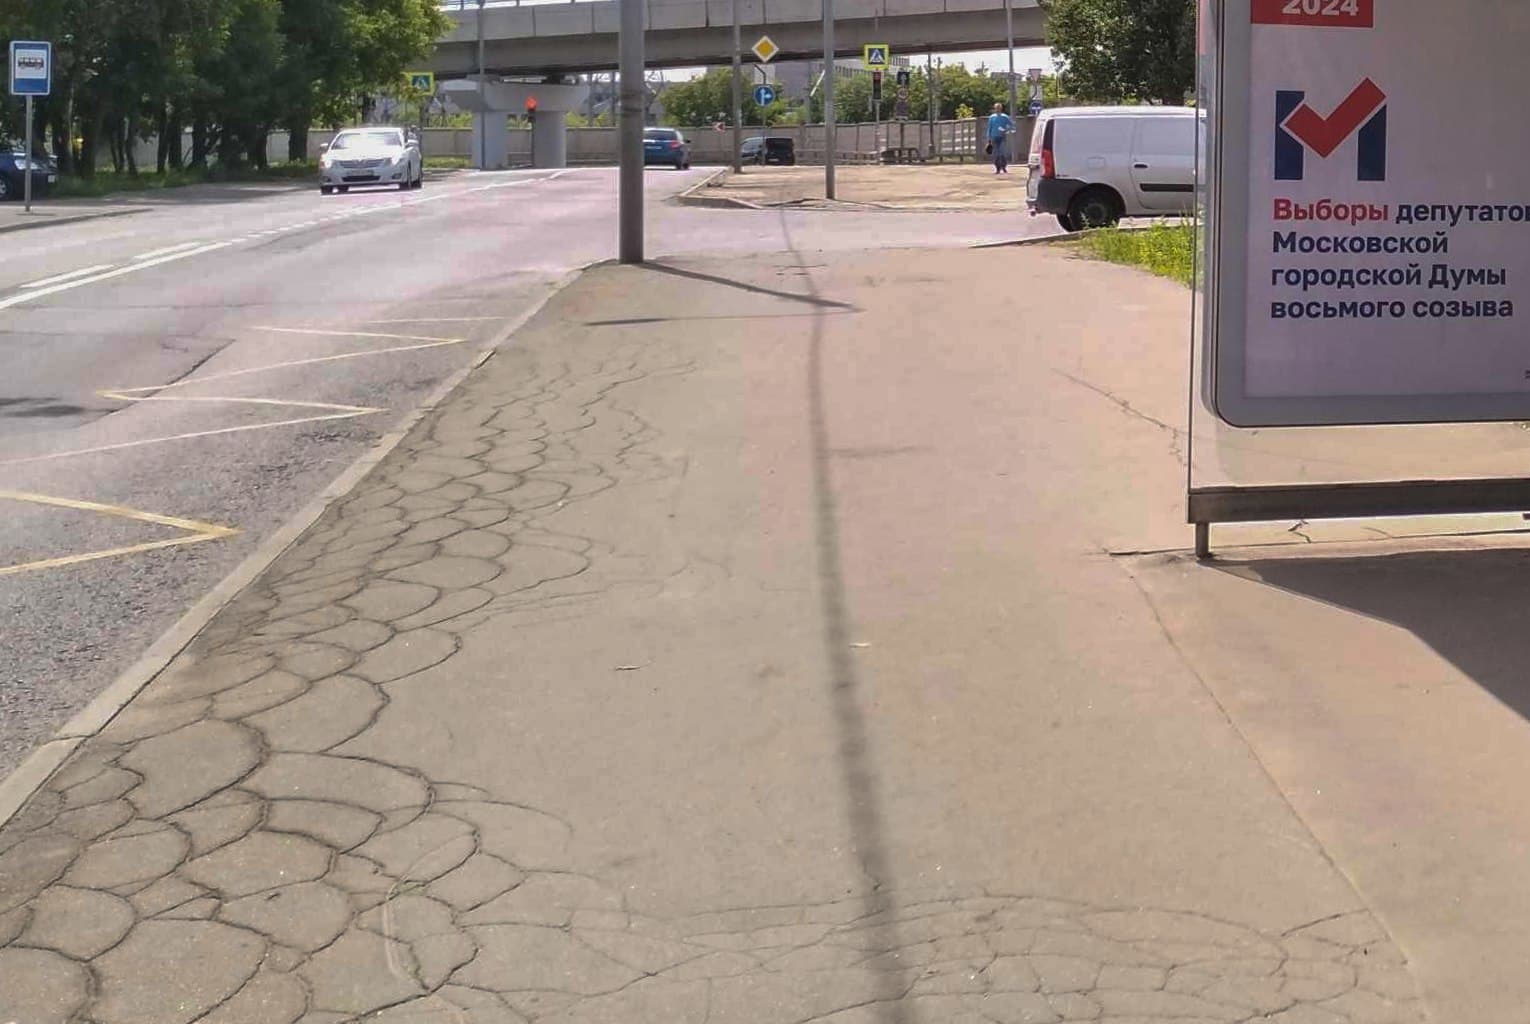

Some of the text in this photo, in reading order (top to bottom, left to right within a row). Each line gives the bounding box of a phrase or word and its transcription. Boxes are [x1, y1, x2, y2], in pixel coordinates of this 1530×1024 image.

[1272, 199, 1389, 225] Выборы
[1272, 230, 1449, 254] Московской
[1271, 264, 1506, 291] городской Думы
[1271, 298, 1514, 318] восьмого созыва
